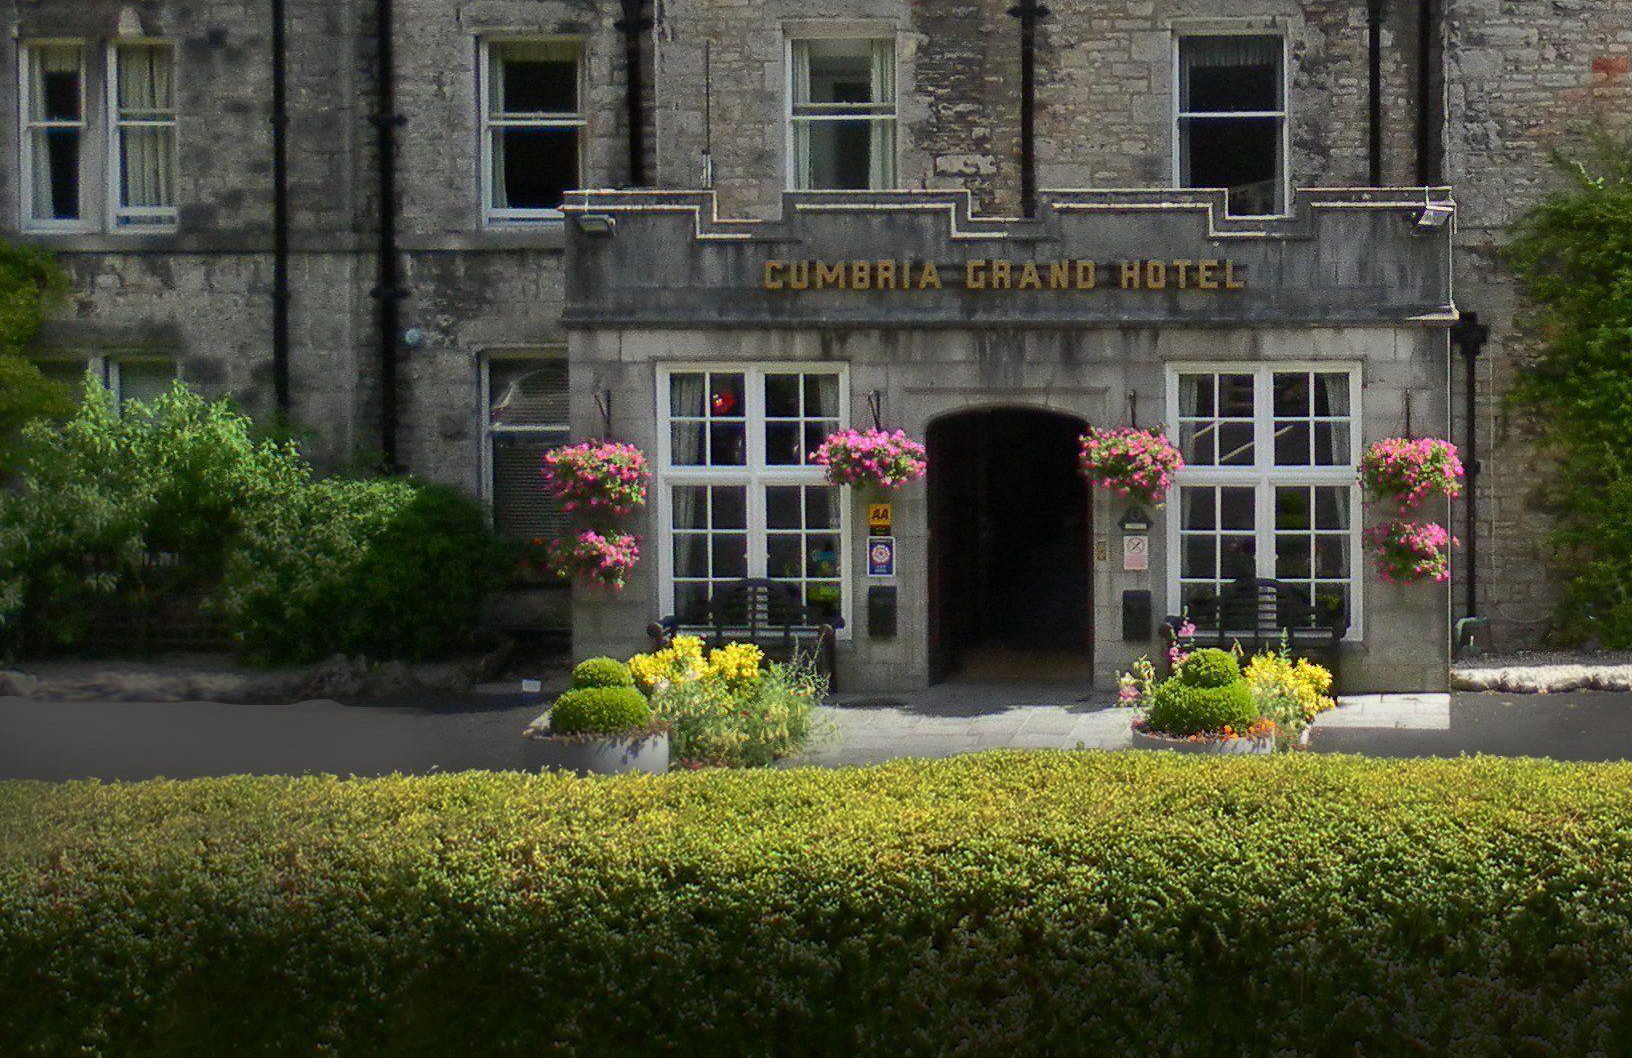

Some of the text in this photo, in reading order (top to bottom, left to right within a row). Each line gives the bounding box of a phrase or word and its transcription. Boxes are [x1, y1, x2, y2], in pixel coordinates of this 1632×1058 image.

[765, 259, 1244, 289] CUMBRIA GRAND HOTEL
[872, 508, 888, 520] AA
